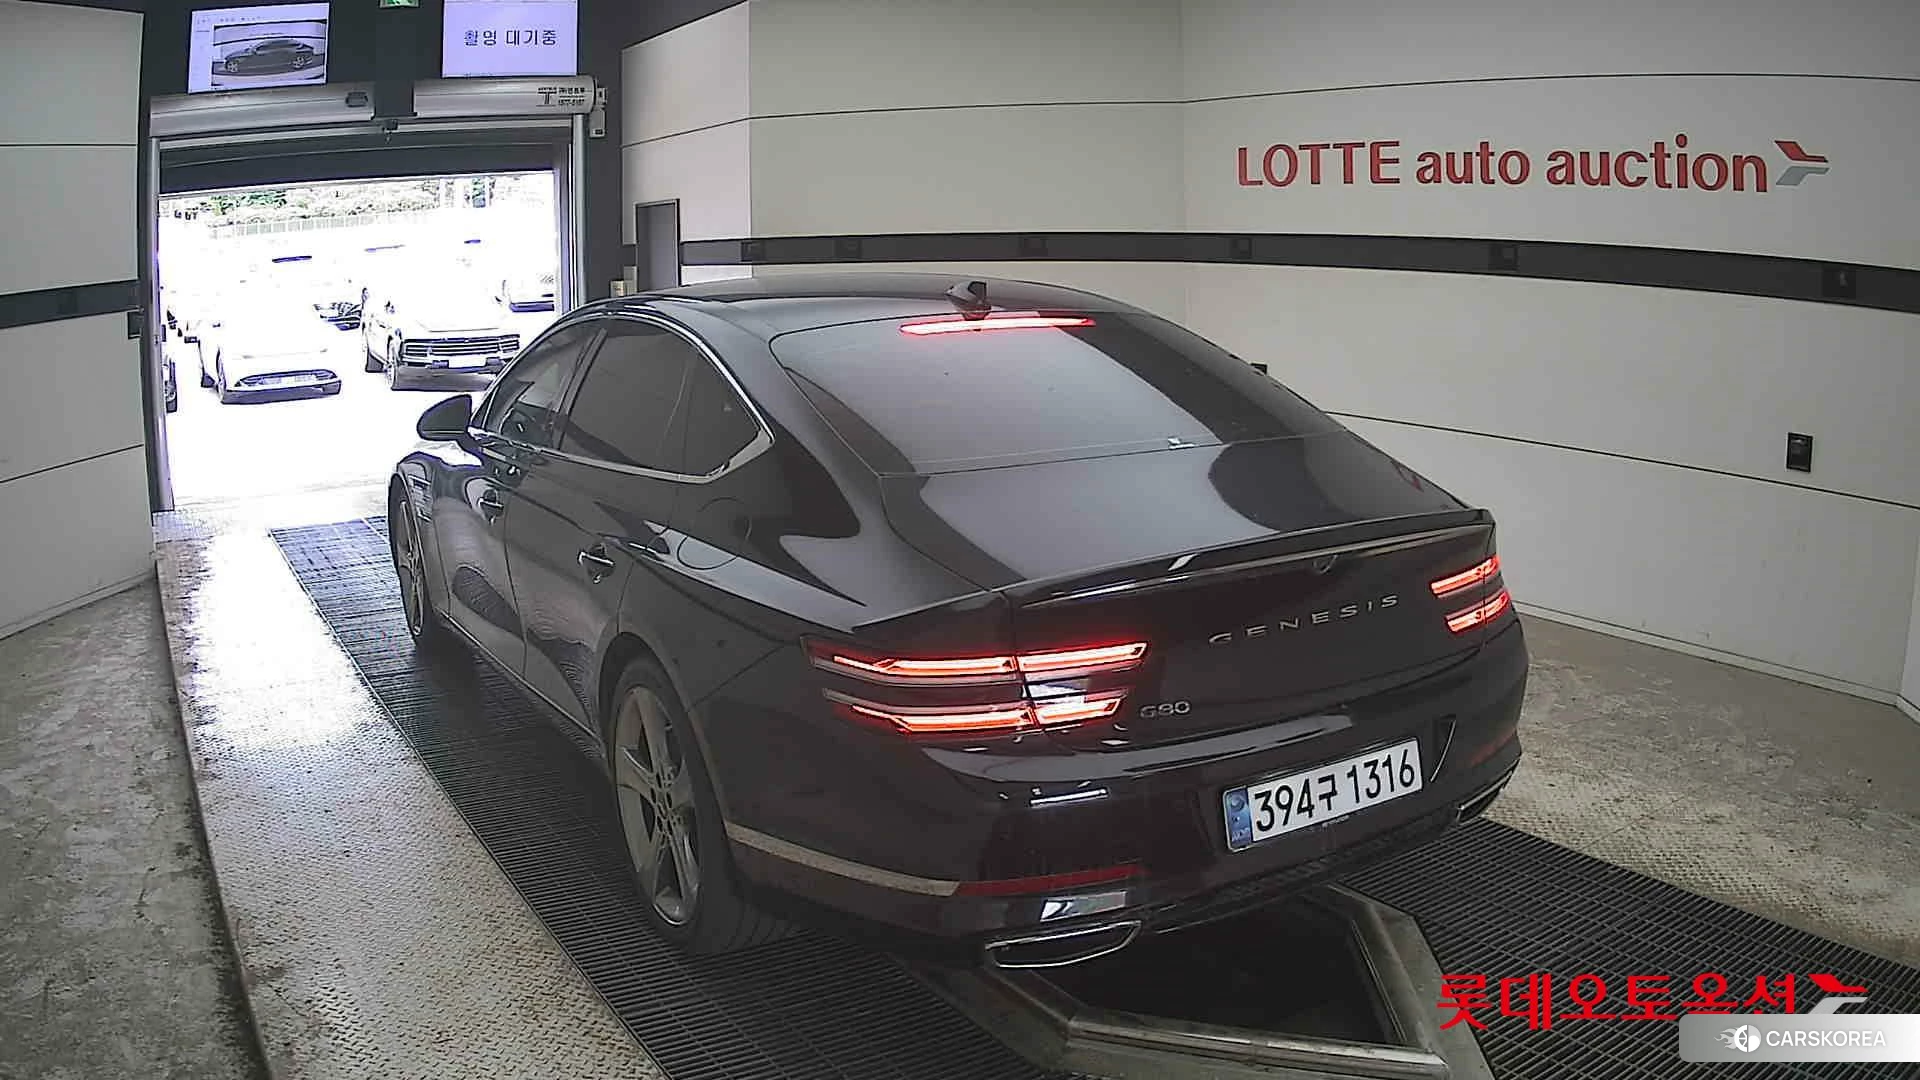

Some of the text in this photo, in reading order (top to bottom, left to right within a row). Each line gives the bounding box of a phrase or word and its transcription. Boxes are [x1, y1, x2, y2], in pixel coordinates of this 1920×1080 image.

[506, 29, 557, 46] 대기중
[1238, 134, 1767, 192] LOTTE auto auction
[1209, 595, 1398, 644] GENESIS
[1254, 749, 1415, 832] 394구 1316
